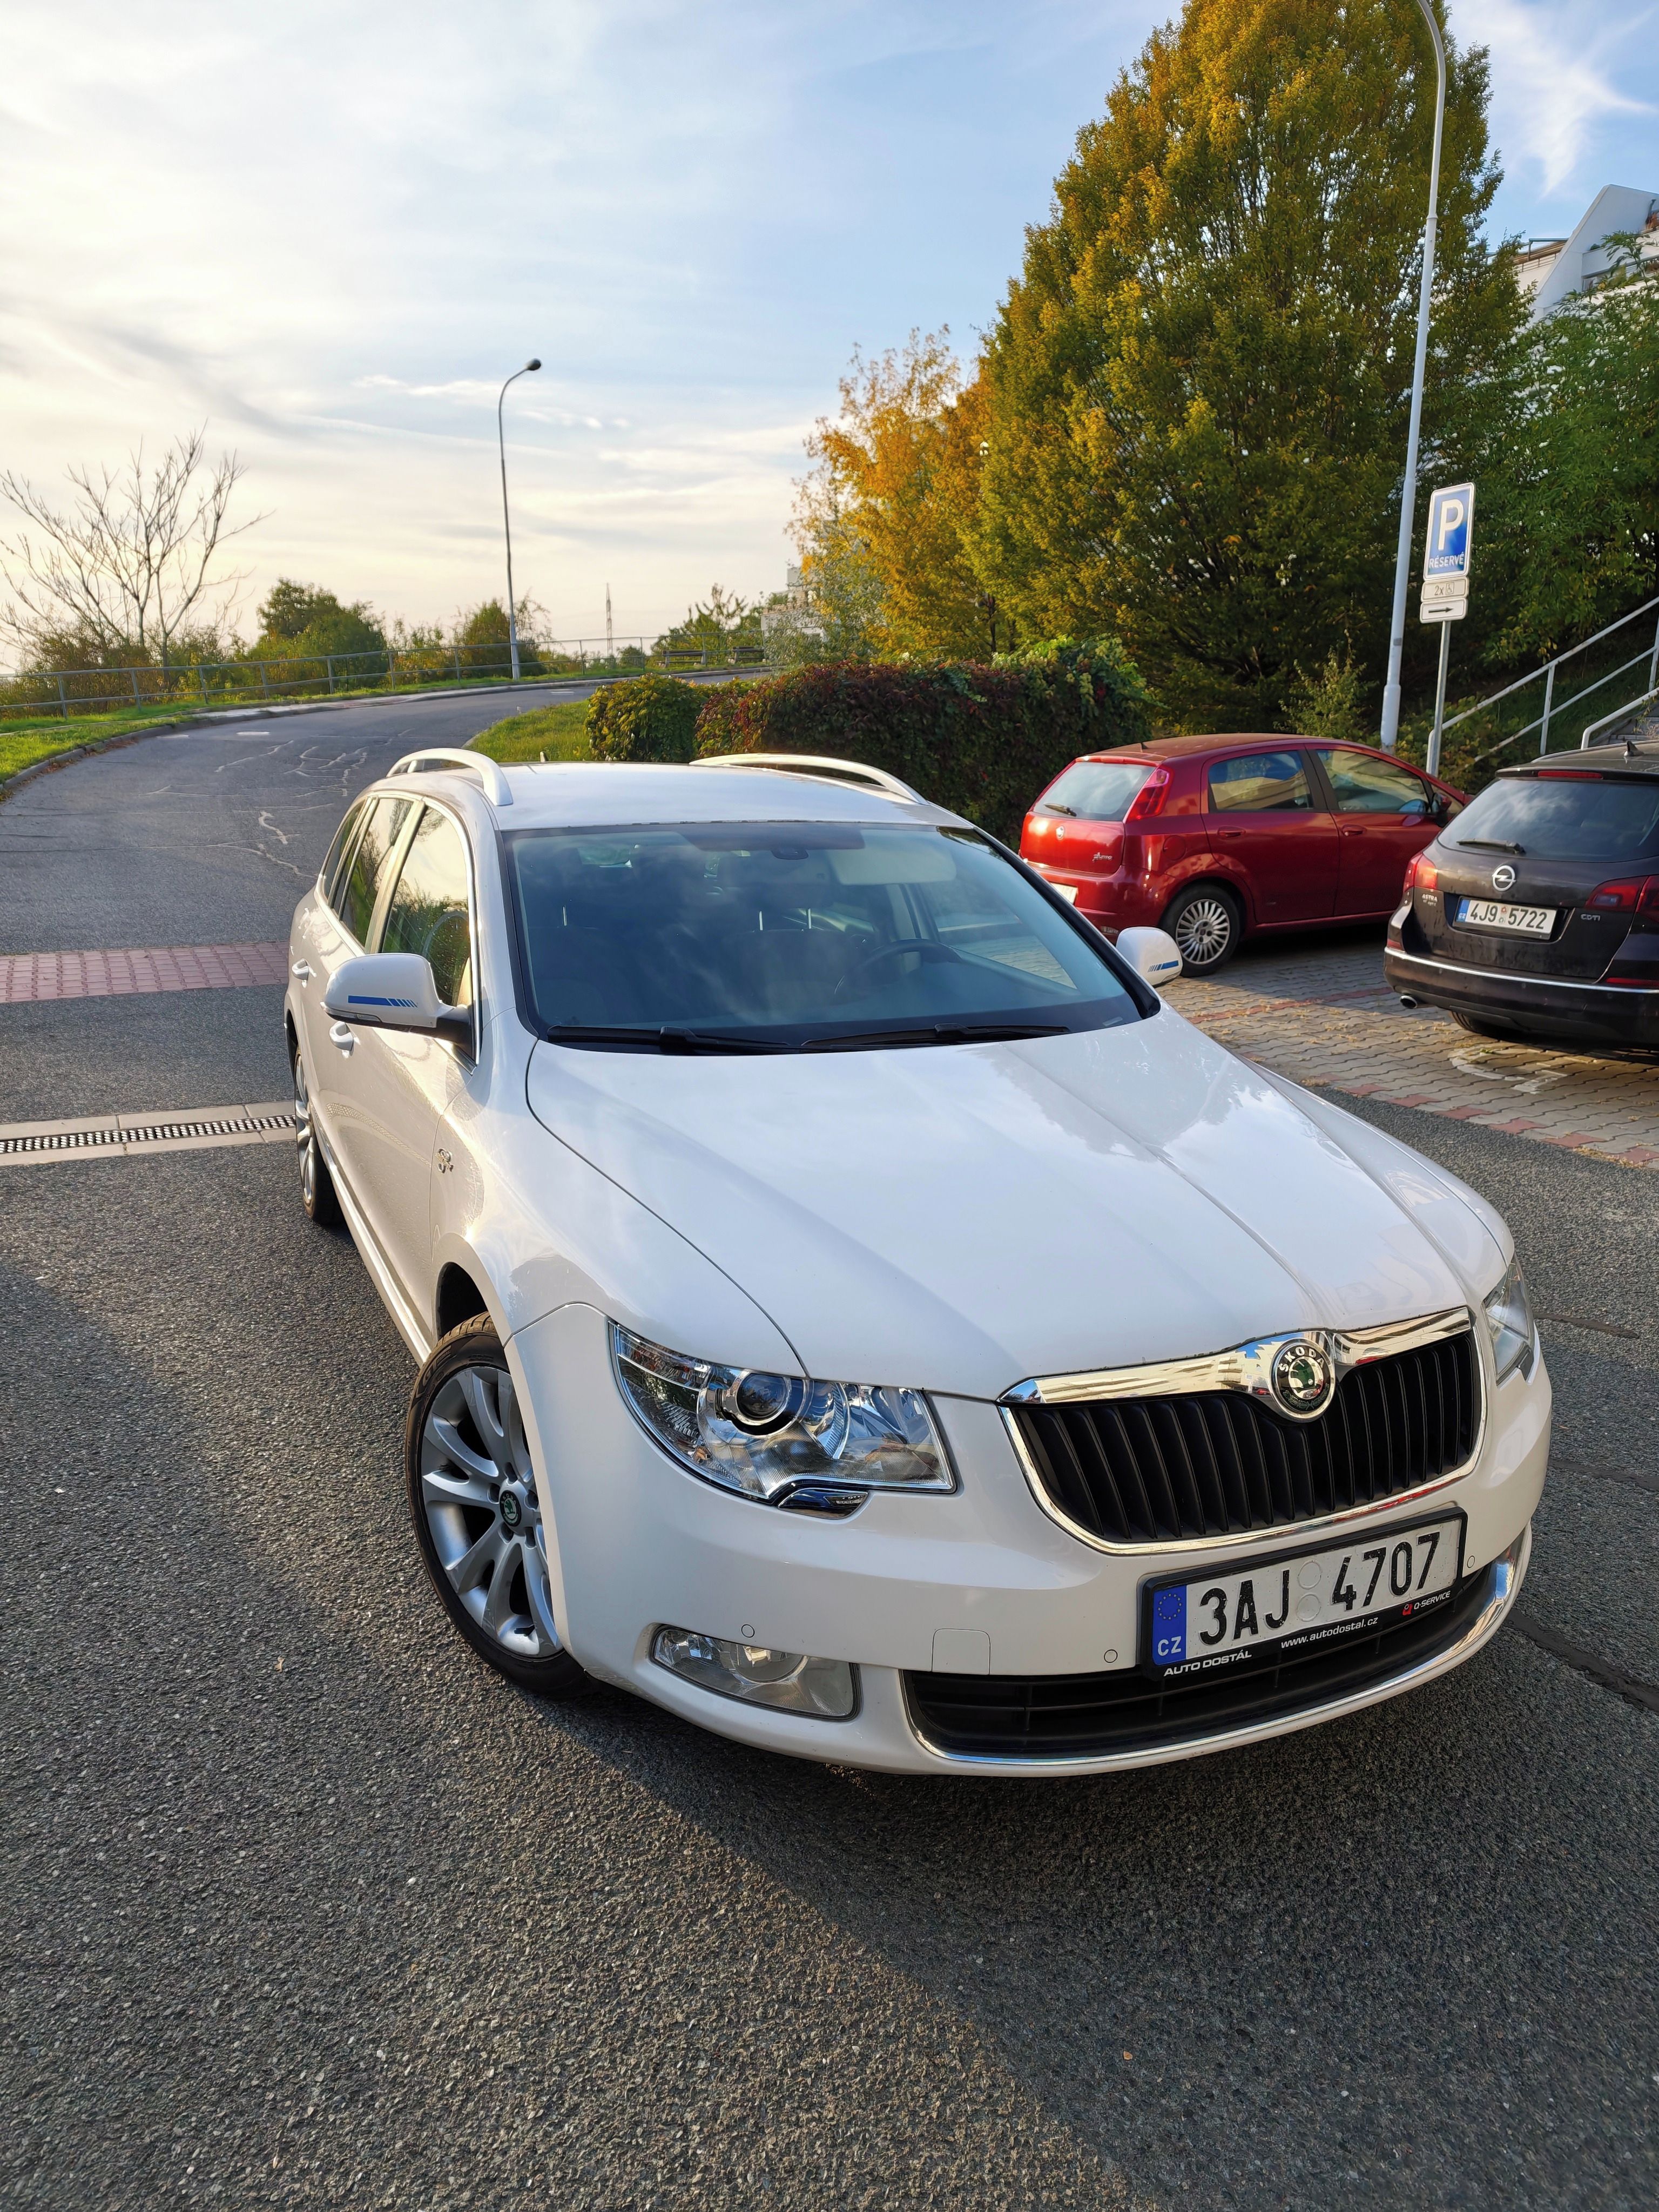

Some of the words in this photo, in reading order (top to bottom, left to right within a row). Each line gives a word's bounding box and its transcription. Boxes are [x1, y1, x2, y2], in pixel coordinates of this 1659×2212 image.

[1438, 499, 1464, 550] P
[1421, 893, 1438, 902] ASTRA
[1470, 903, 1498, 922] 4J9
[1508, 907, 1548, 929] 5722
[1199, 1569, 1291, 1646] 3AJ
[1331, 1531, 1441, 1611] 4707
[1157, 1635, 1182, 1656] CZ
[1280, 1616, 1379, 1649] www.autodostal.cz
[1163, 1662, 1201, 1677] AUTO
[1202, 1649, 1252, 1668] DOSTÁL
